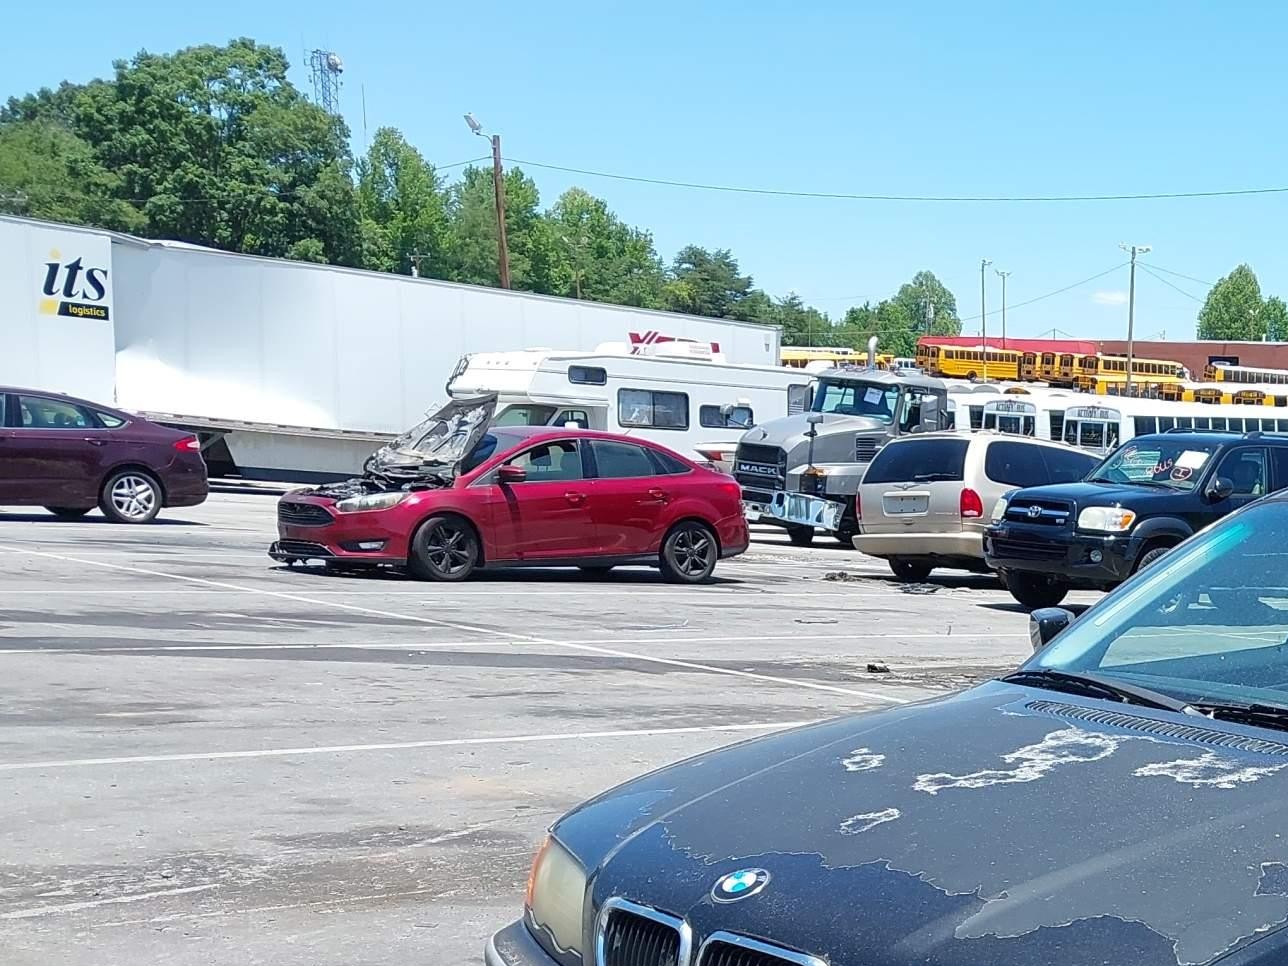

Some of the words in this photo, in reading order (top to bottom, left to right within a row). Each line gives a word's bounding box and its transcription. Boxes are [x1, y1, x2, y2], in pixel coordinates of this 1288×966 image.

[43, 248, 108, 301] its
[68, 303, 106, 317] logistics
[740, 464, 777, 475] MACK
